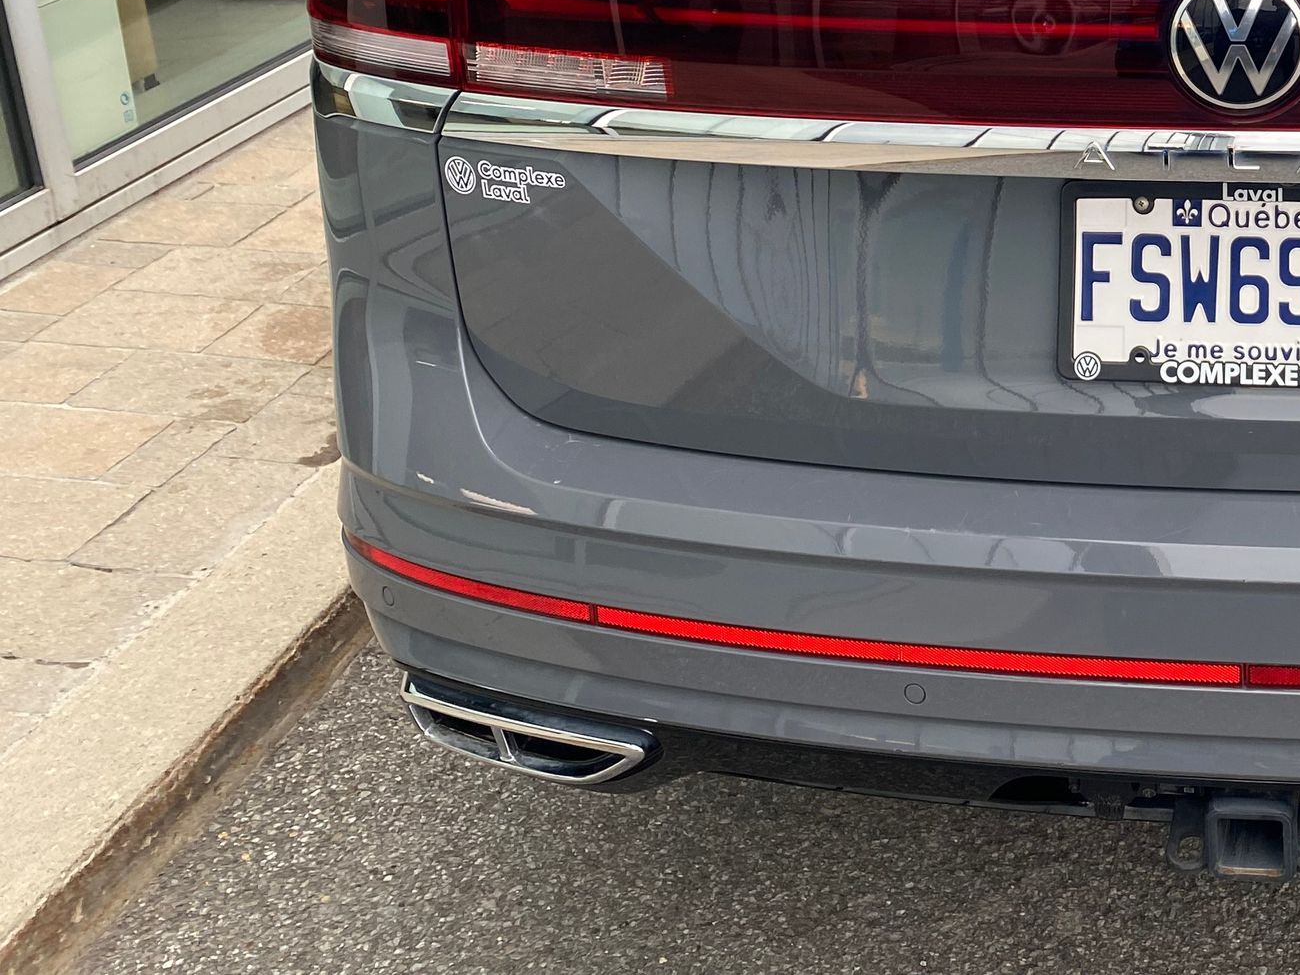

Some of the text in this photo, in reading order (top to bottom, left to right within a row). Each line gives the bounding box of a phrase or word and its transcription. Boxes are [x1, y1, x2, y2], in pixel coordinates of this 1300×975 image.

[478, 160, 565, 188] Complexe
[481, 179, 531, 204] Laval
[1222, 182, 1283, 203] Laval
[1151, 338, 1178, 359] Je
[1187, 343, 1224, 360] me
[1159, 360, 1299, 387] COMPLEXE
